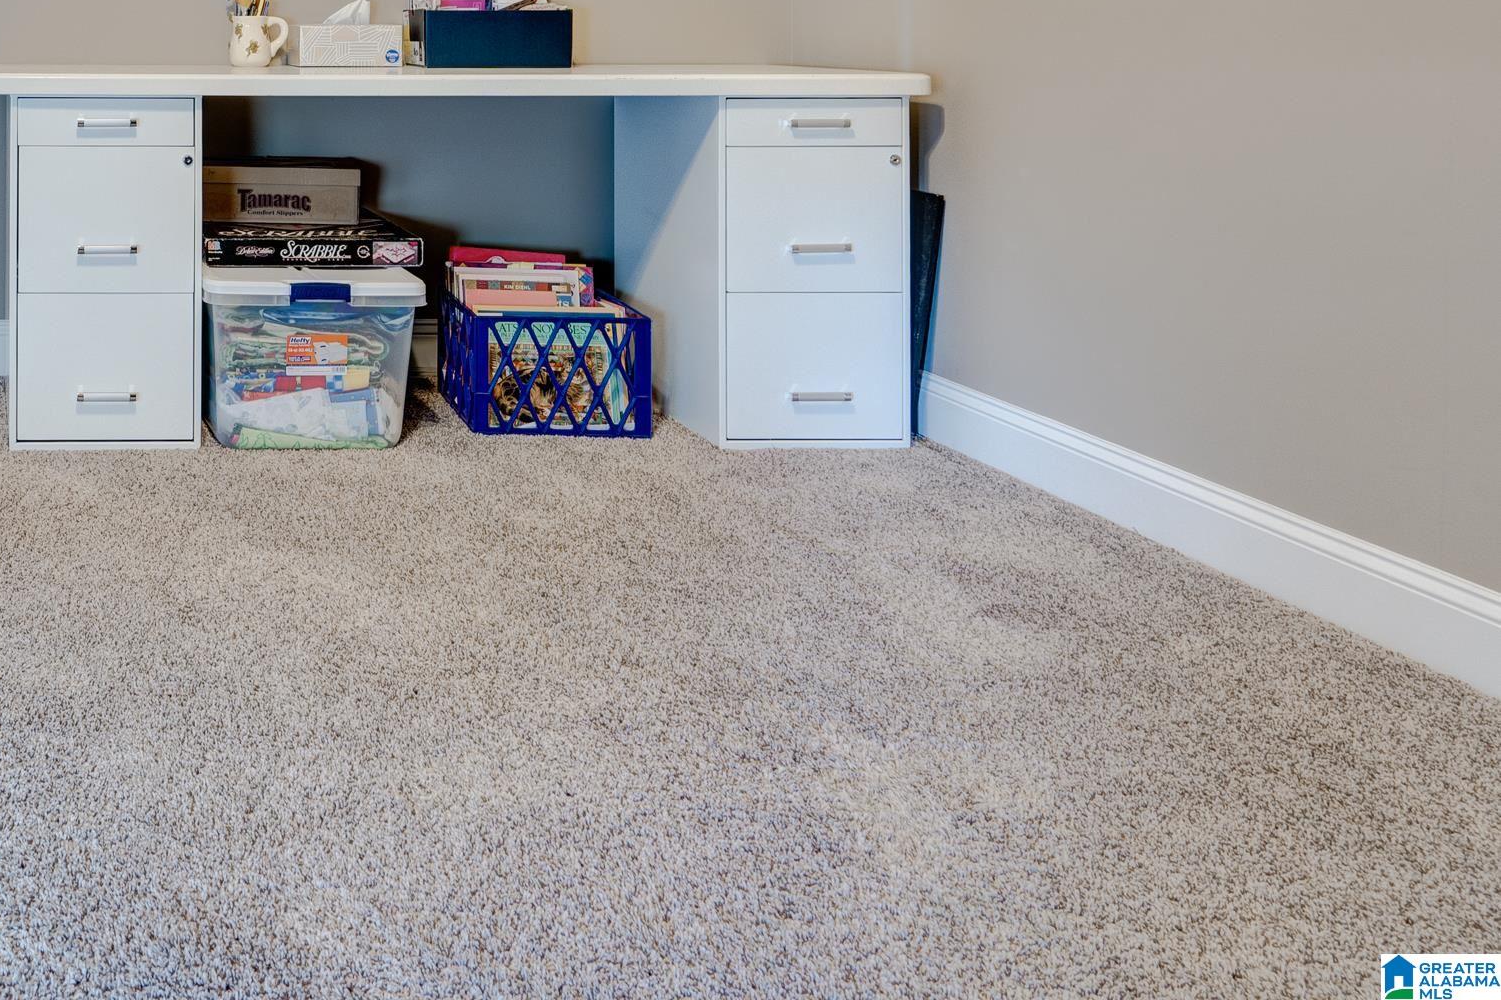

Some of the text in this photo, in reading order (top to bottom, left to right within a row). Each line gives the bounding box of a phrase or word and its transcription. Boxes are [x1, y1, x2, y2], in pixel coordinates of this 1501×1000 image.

[237, 188, 311, 213] Tamarac
[276, 210, 303, 218] Slippers
[280, 240, 347, 262] SCRABBLE
